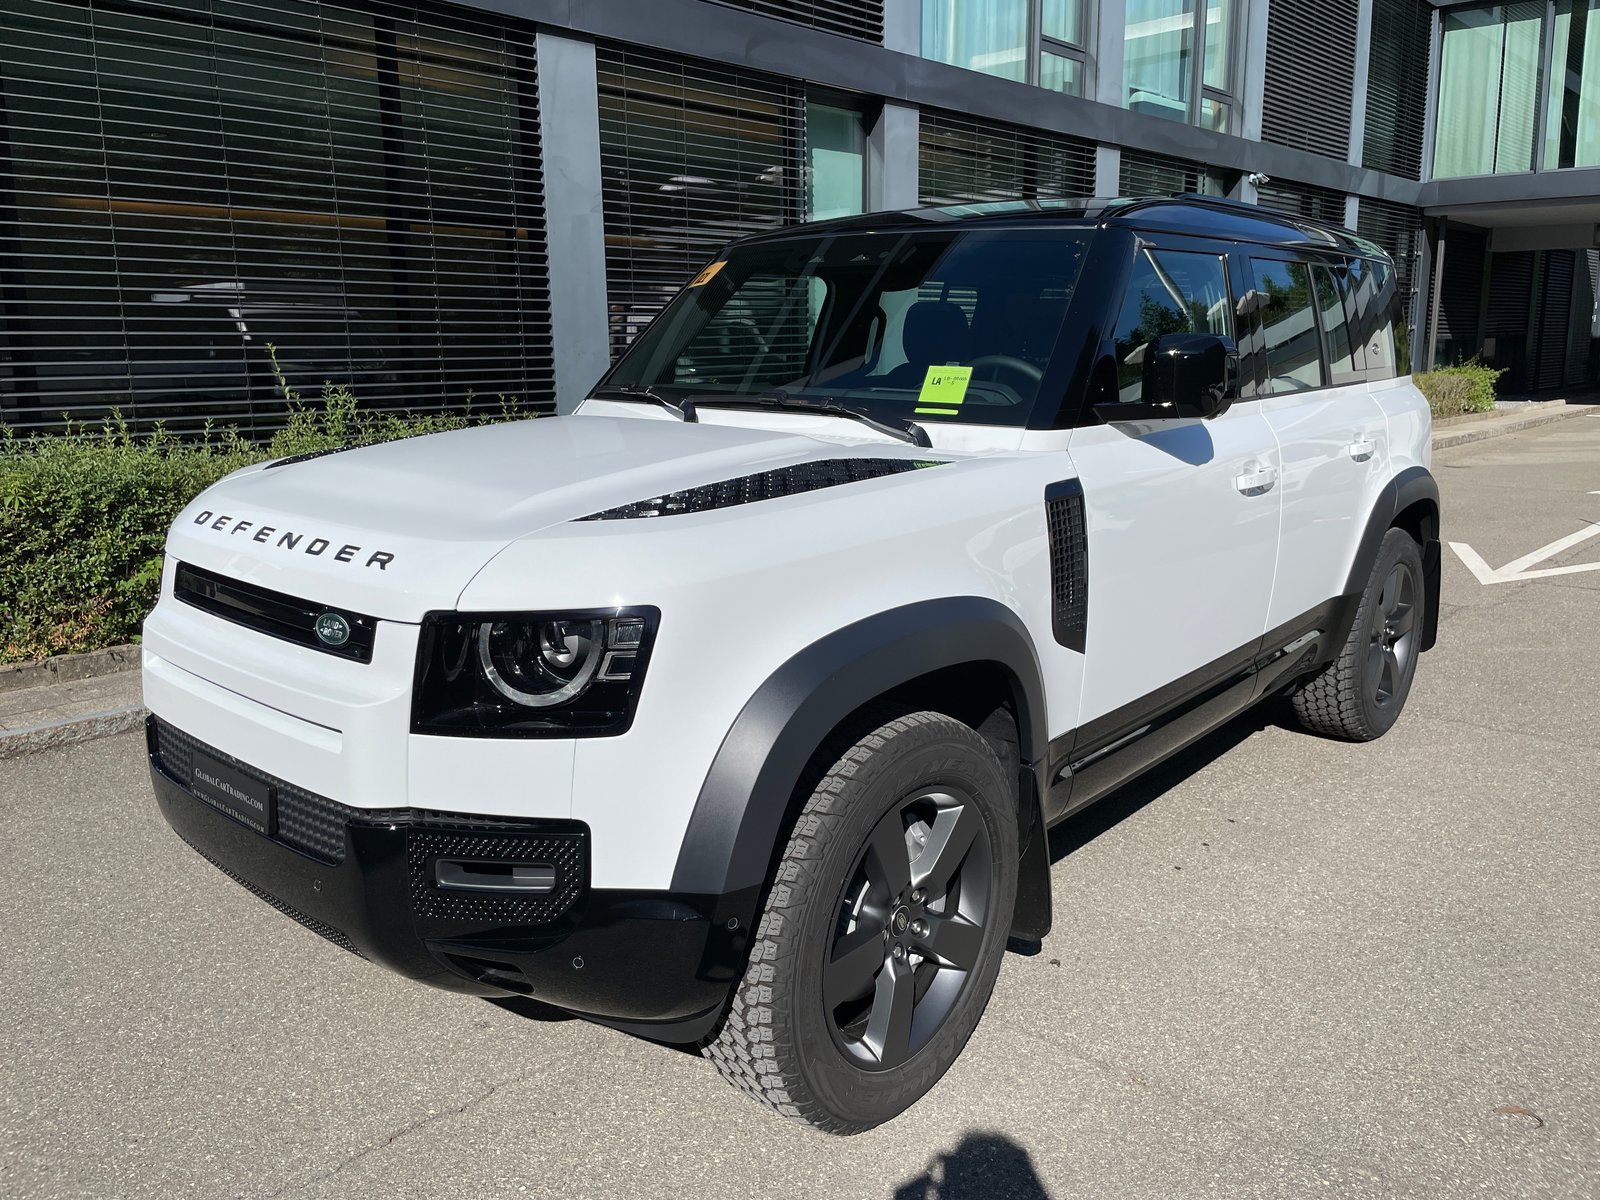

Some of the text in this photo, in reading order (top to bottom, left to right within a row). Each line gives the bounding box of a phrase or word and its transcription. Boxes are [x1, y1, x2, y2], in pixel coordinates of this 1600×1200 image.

[193, 510, 395, 571] DEFENDER
[322, 618, 339, 630] LAND
[322, 627, 343, 639] ROVER
